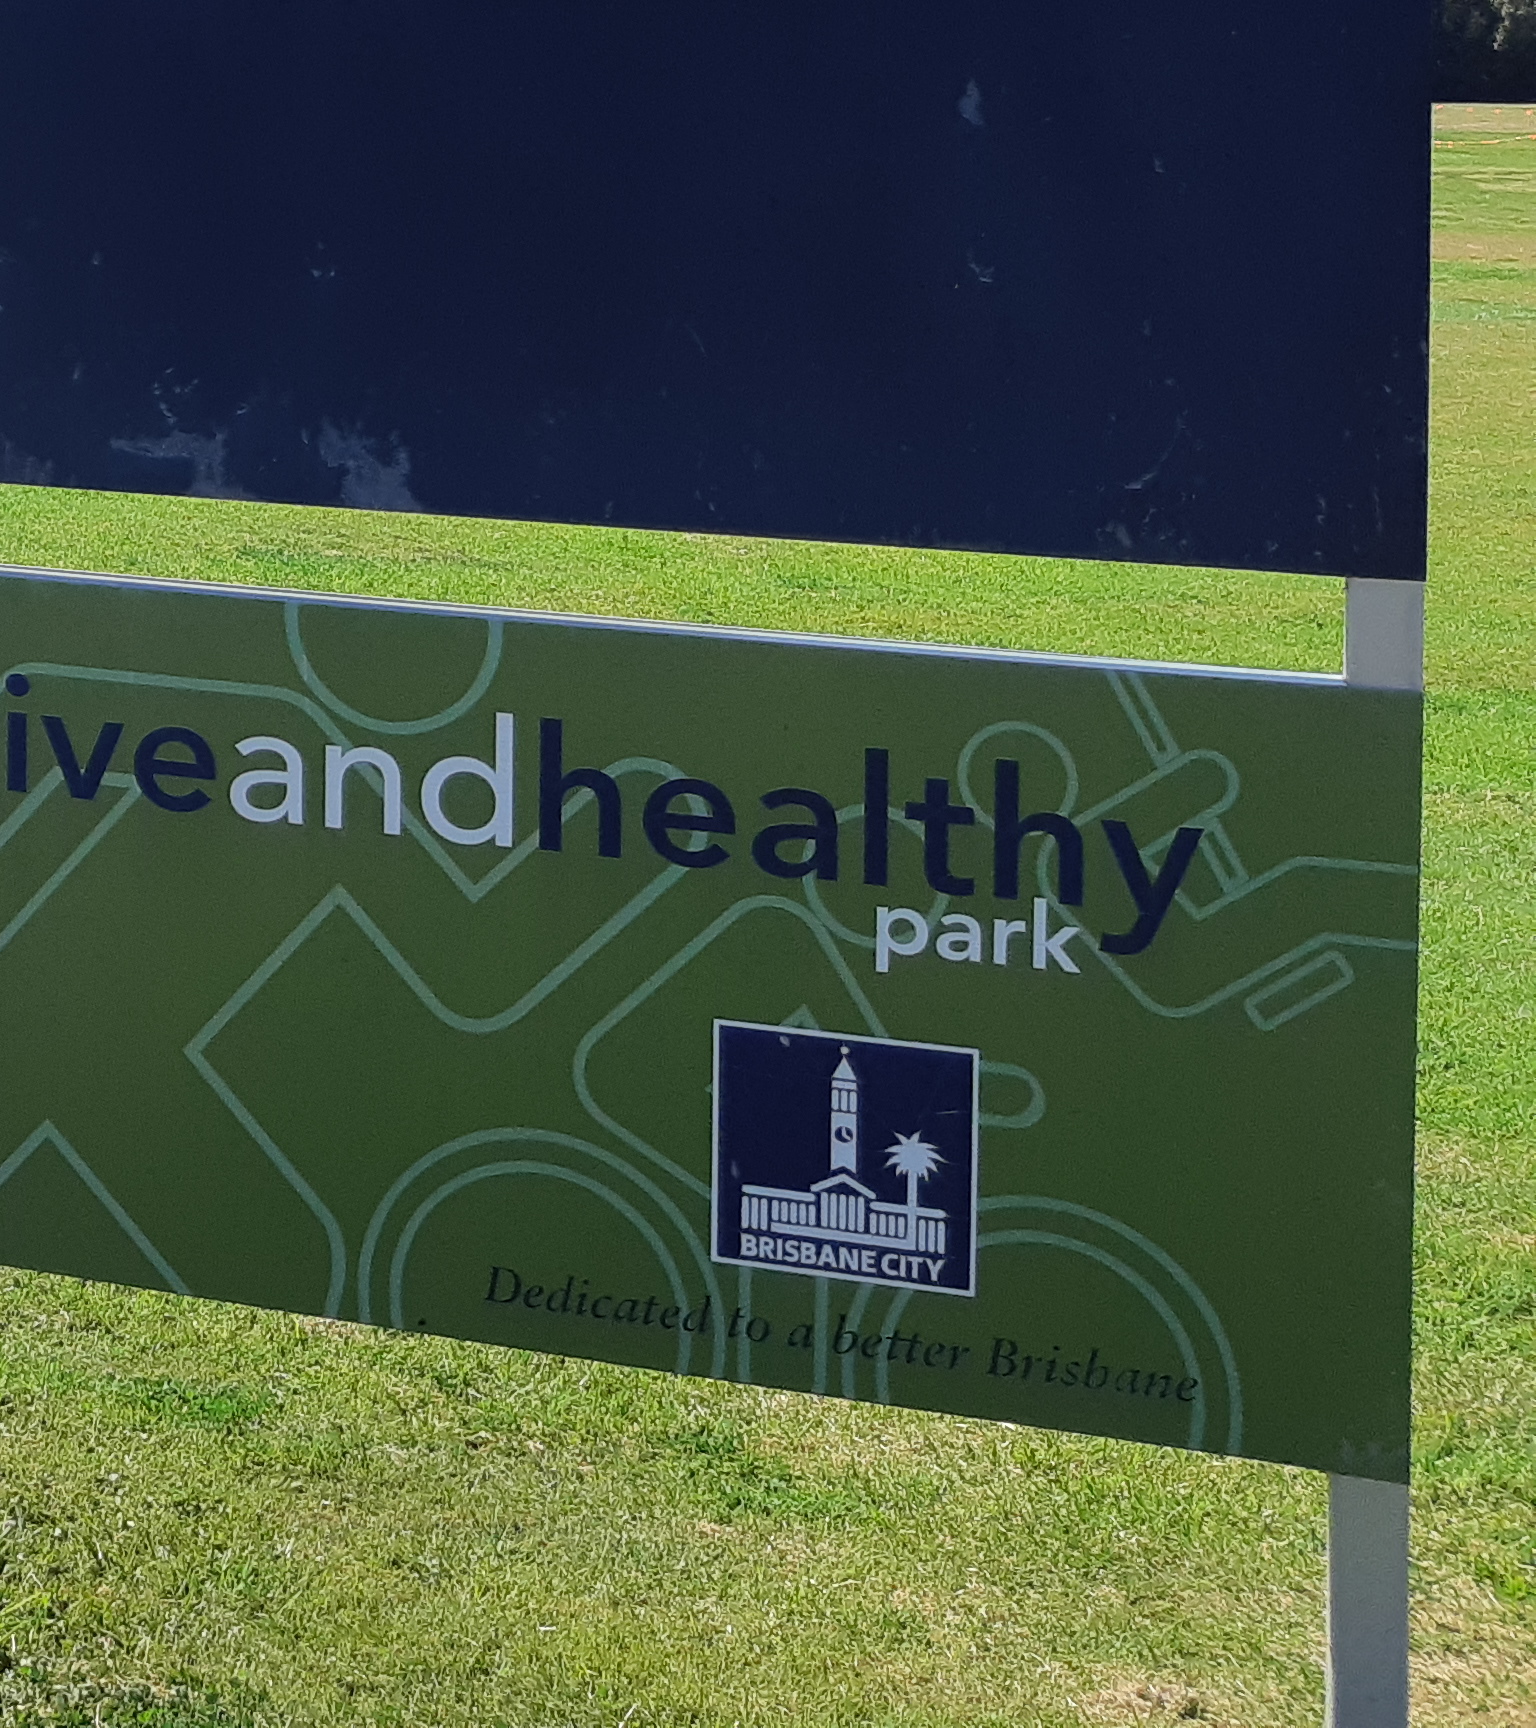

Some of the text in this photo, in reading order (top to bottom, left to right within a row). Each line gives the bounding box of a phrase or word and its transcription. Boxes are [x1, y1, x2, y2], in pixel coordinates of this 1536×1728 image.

[874, 896, 1081, 974] park
[739, 1232, 946, 1282] BRISBANE CITY
[484, 1265, 1200, 1402] Dedicated to a better Brisbane
